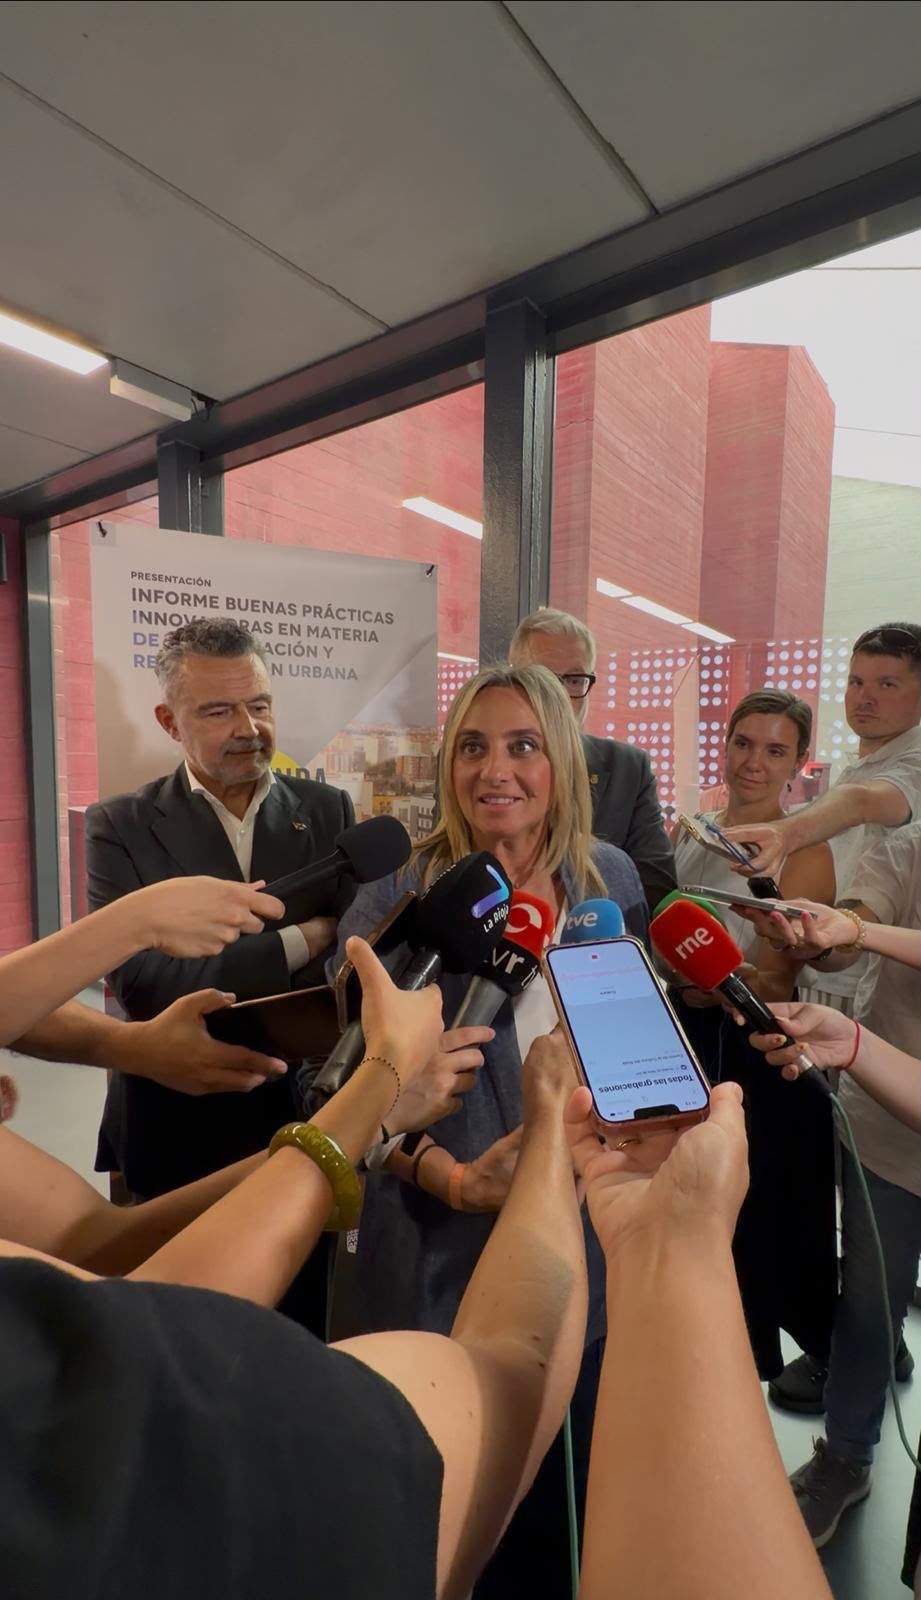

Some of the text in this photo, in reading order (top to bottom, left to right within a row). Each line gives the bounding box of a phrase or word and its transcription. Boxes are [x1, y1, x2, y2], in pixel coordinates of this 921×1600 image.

[130, 571, 212, 587] PRESENTACIÓN
[132, 588, 394, 625] INFORME BUENAS PRÁCTICAS
[278, 622, 301, 637] EN
[307, 625, 379, 643] MATERIA
[133, 632, 159, 647] DE
[323, 646, 334, 659] Y
[289, 664, 358, 680] URBANA
[675, 927, 714, 960] rne
[598, 1078, 653, 1093] grabaciones
[667, 1073, 694, 1082] Todas
